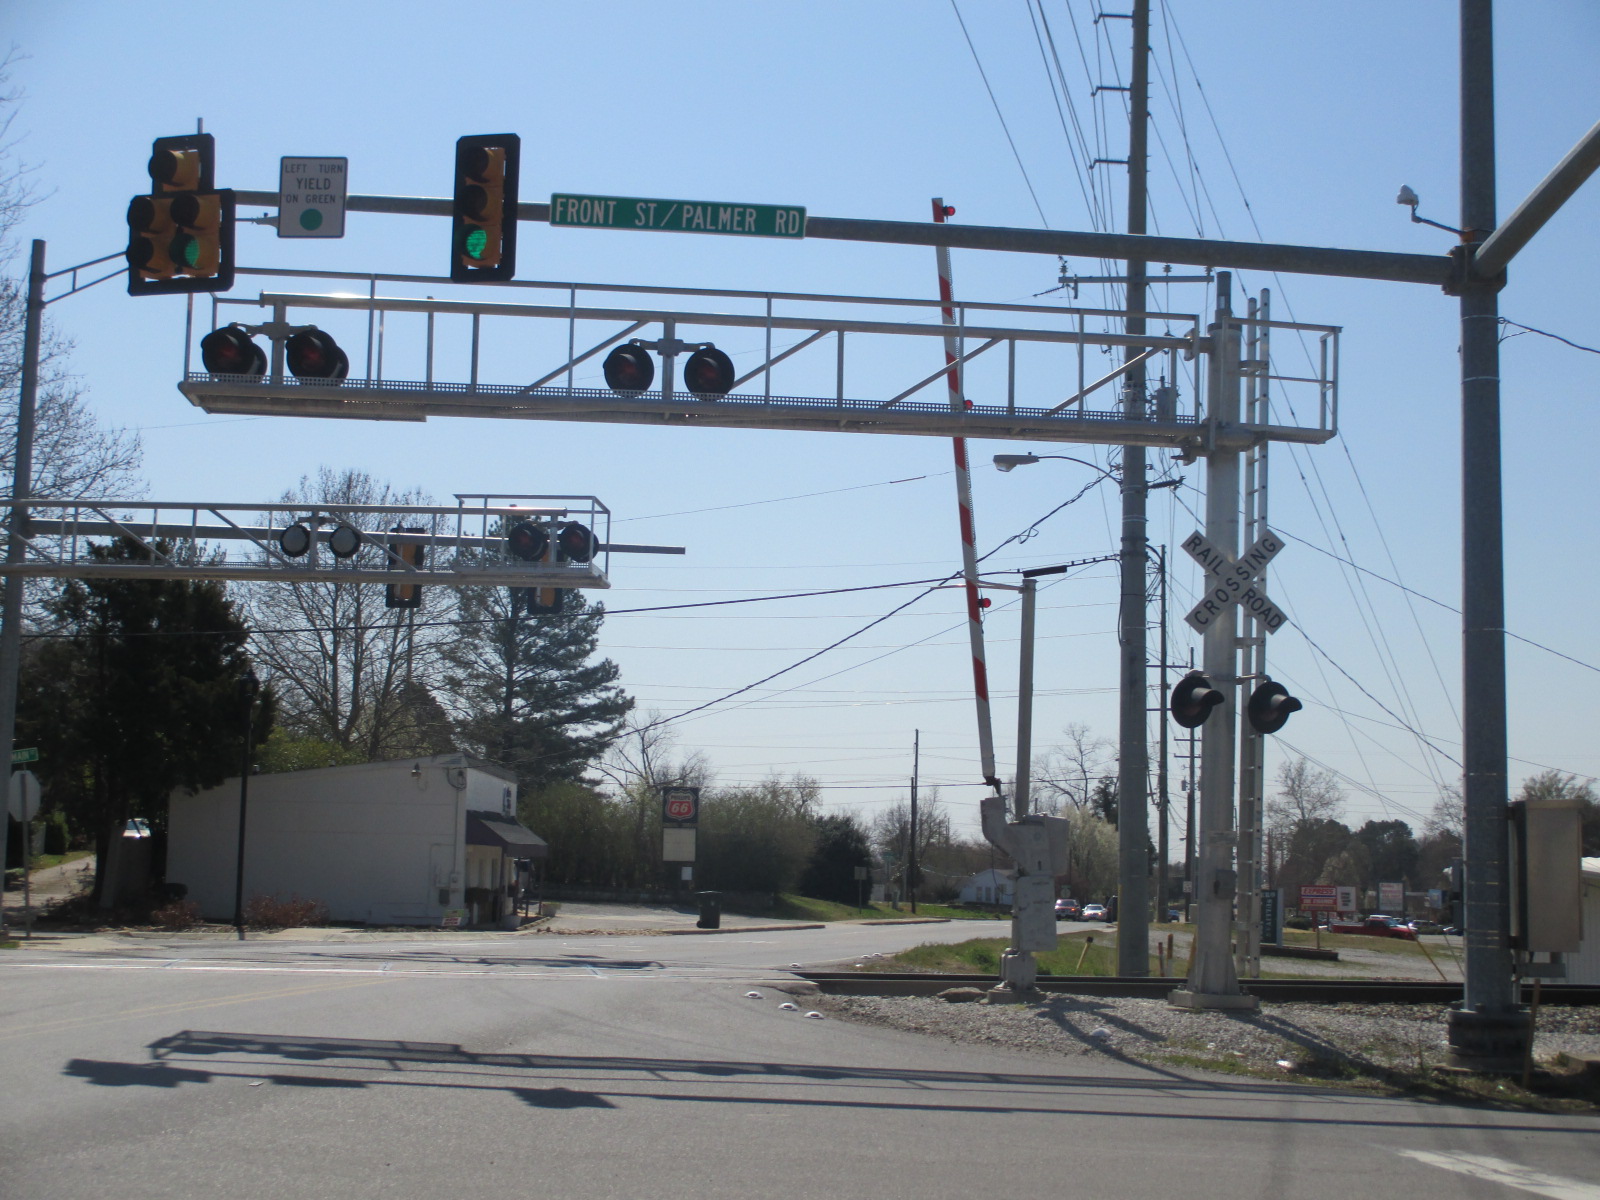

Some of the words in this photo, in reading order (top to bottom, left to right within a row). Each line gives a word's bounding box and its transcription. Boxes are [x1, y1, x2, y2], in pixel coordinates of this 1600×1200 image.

[285, 163, 307, 174] LEFT
[318, 164, 343, 174] TURN
[296, 177, 331, 190] YIELD
[286, 194, 298, 204] ON
[306, 194, 336, 204] GREEN
[555, 198, 617, 225] FRONT
[775, 210, 800, 234] RD
[1194, 538, 1276, 625] CROSSING
[671, 803, 689, 813] 66
